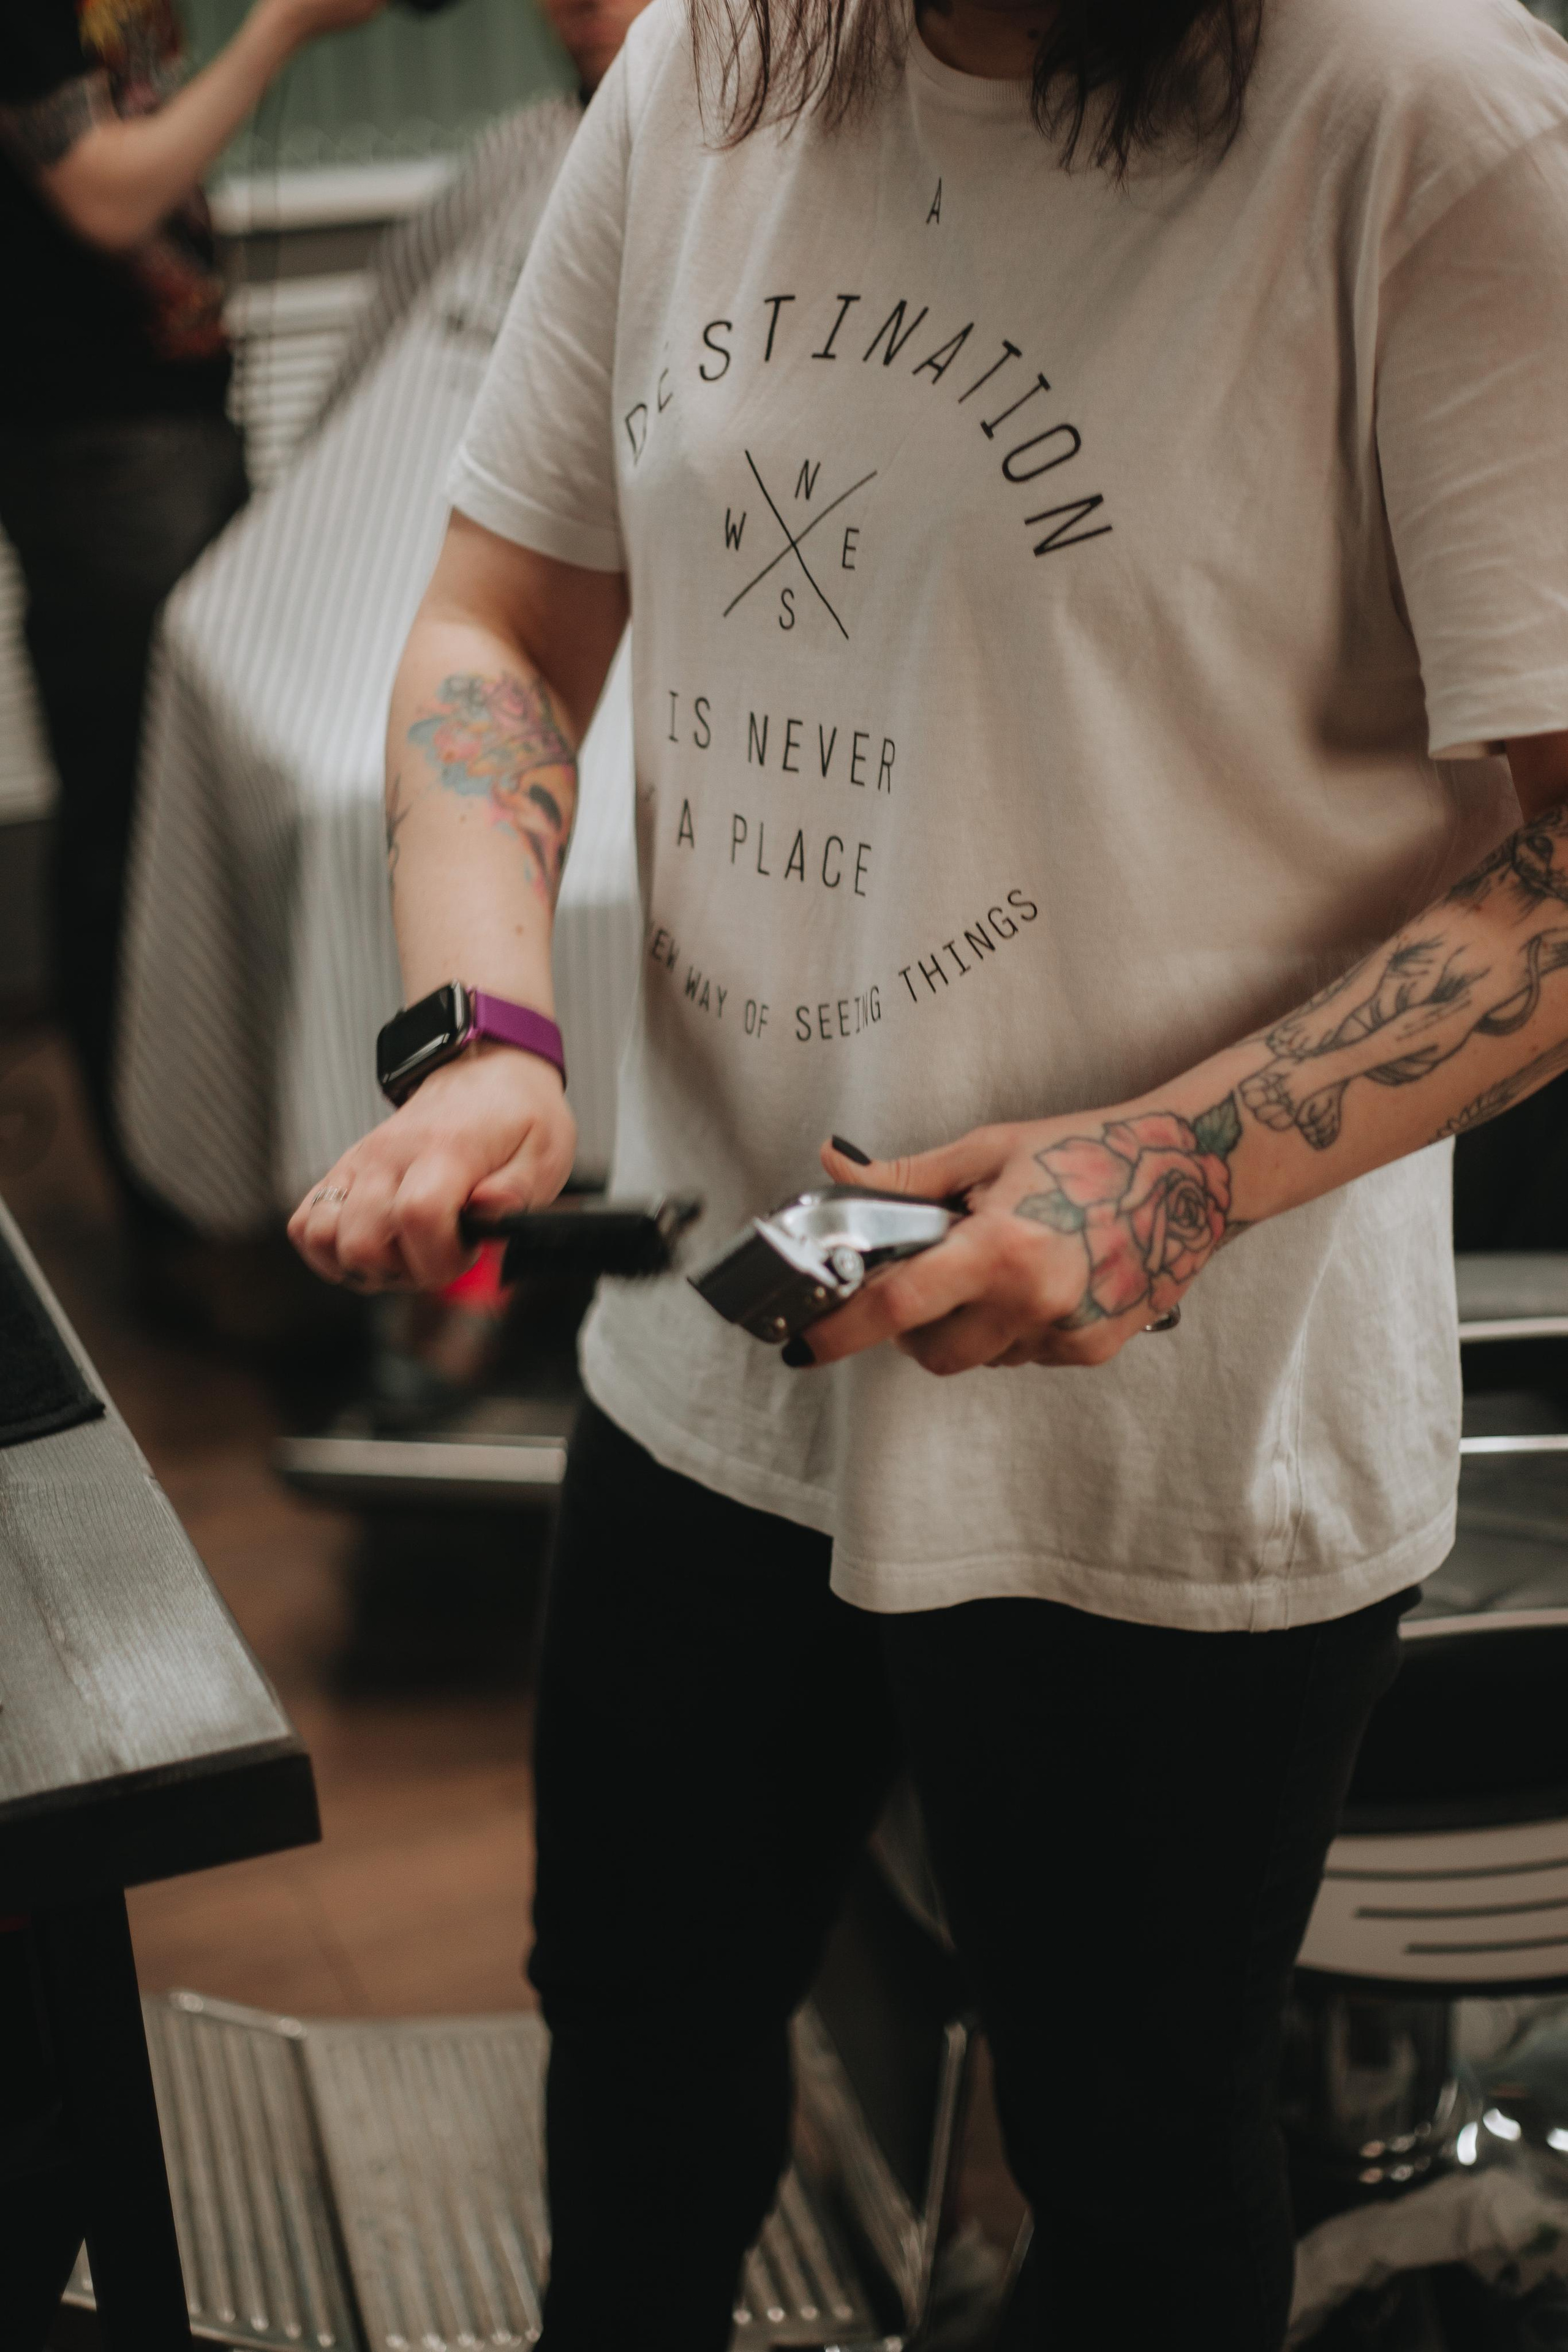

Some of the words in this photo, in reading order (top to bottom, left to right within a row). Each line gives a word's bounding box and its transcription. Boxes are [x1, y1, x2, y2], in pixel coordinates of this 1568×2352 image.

[925, 176, 942, 225] A
[795, 459, 821, 500] N
[725, 508, 747, 551] W
[842, 527, 860, 569] E
[778, 588, 795, 630] S
[668, 690, 711, 749] IS
[748, 711, 896, 794] NEVER
[677, 798, 696, 849] A
[731, 813, 872, 897] PLACE
[649, 925, 680, 970] EW
[684, 965, 728, 1019] WAY
[744, 998, 769, 1038] OF
[796, 984, 882, 1041] SEEING
[898, 889, 1038, 1002] THINGS
